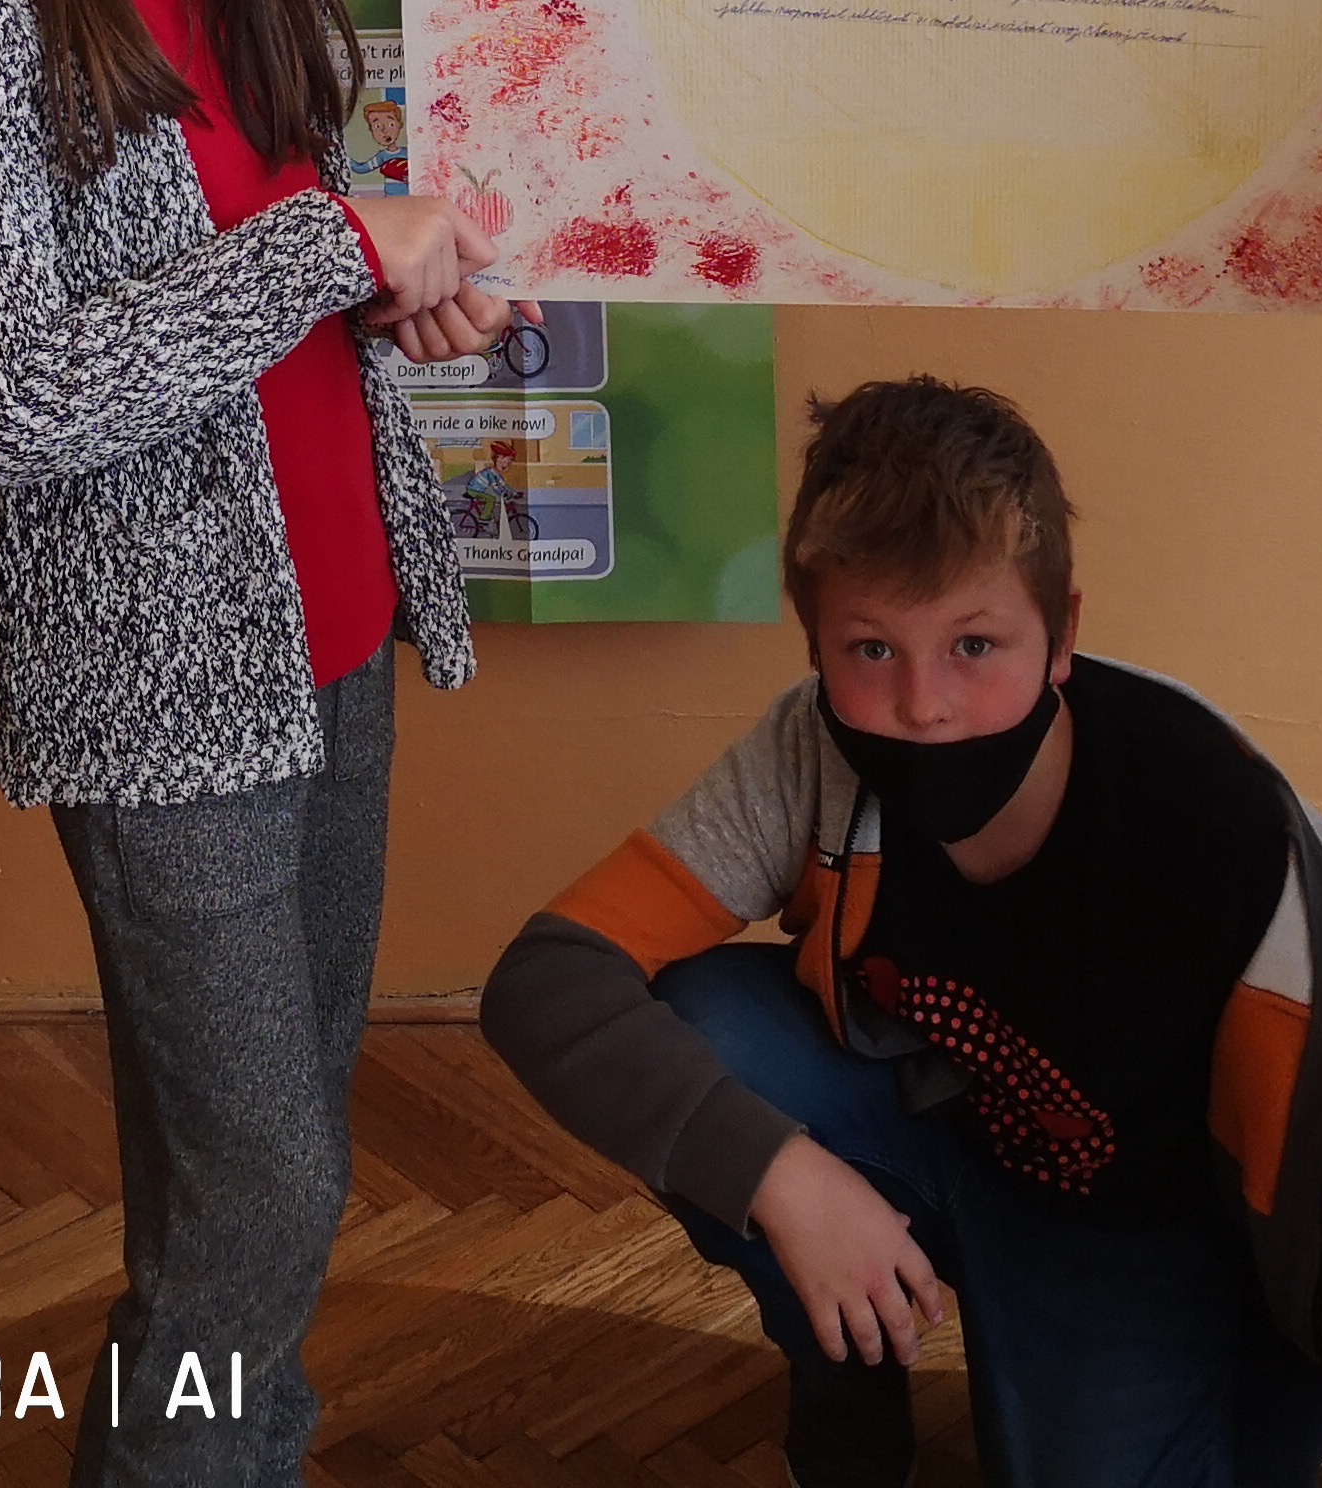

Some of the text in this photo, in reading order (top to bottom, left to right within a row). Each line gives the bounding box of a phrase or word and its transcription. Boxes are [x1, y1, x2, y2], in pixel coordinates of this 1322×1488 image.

[381, 44, 405, 59] rid
[389, 64, 406, 83] pl
[396, 363, 476, 381] Don't stop!
[432, 415, 461, 430] ride
[464, 420, 475, 430] a
[479, 414, 509, 430] bike
[512, 416, 547, 431] now!
[463, 545, 586, 566] Thanks Grandpa!
